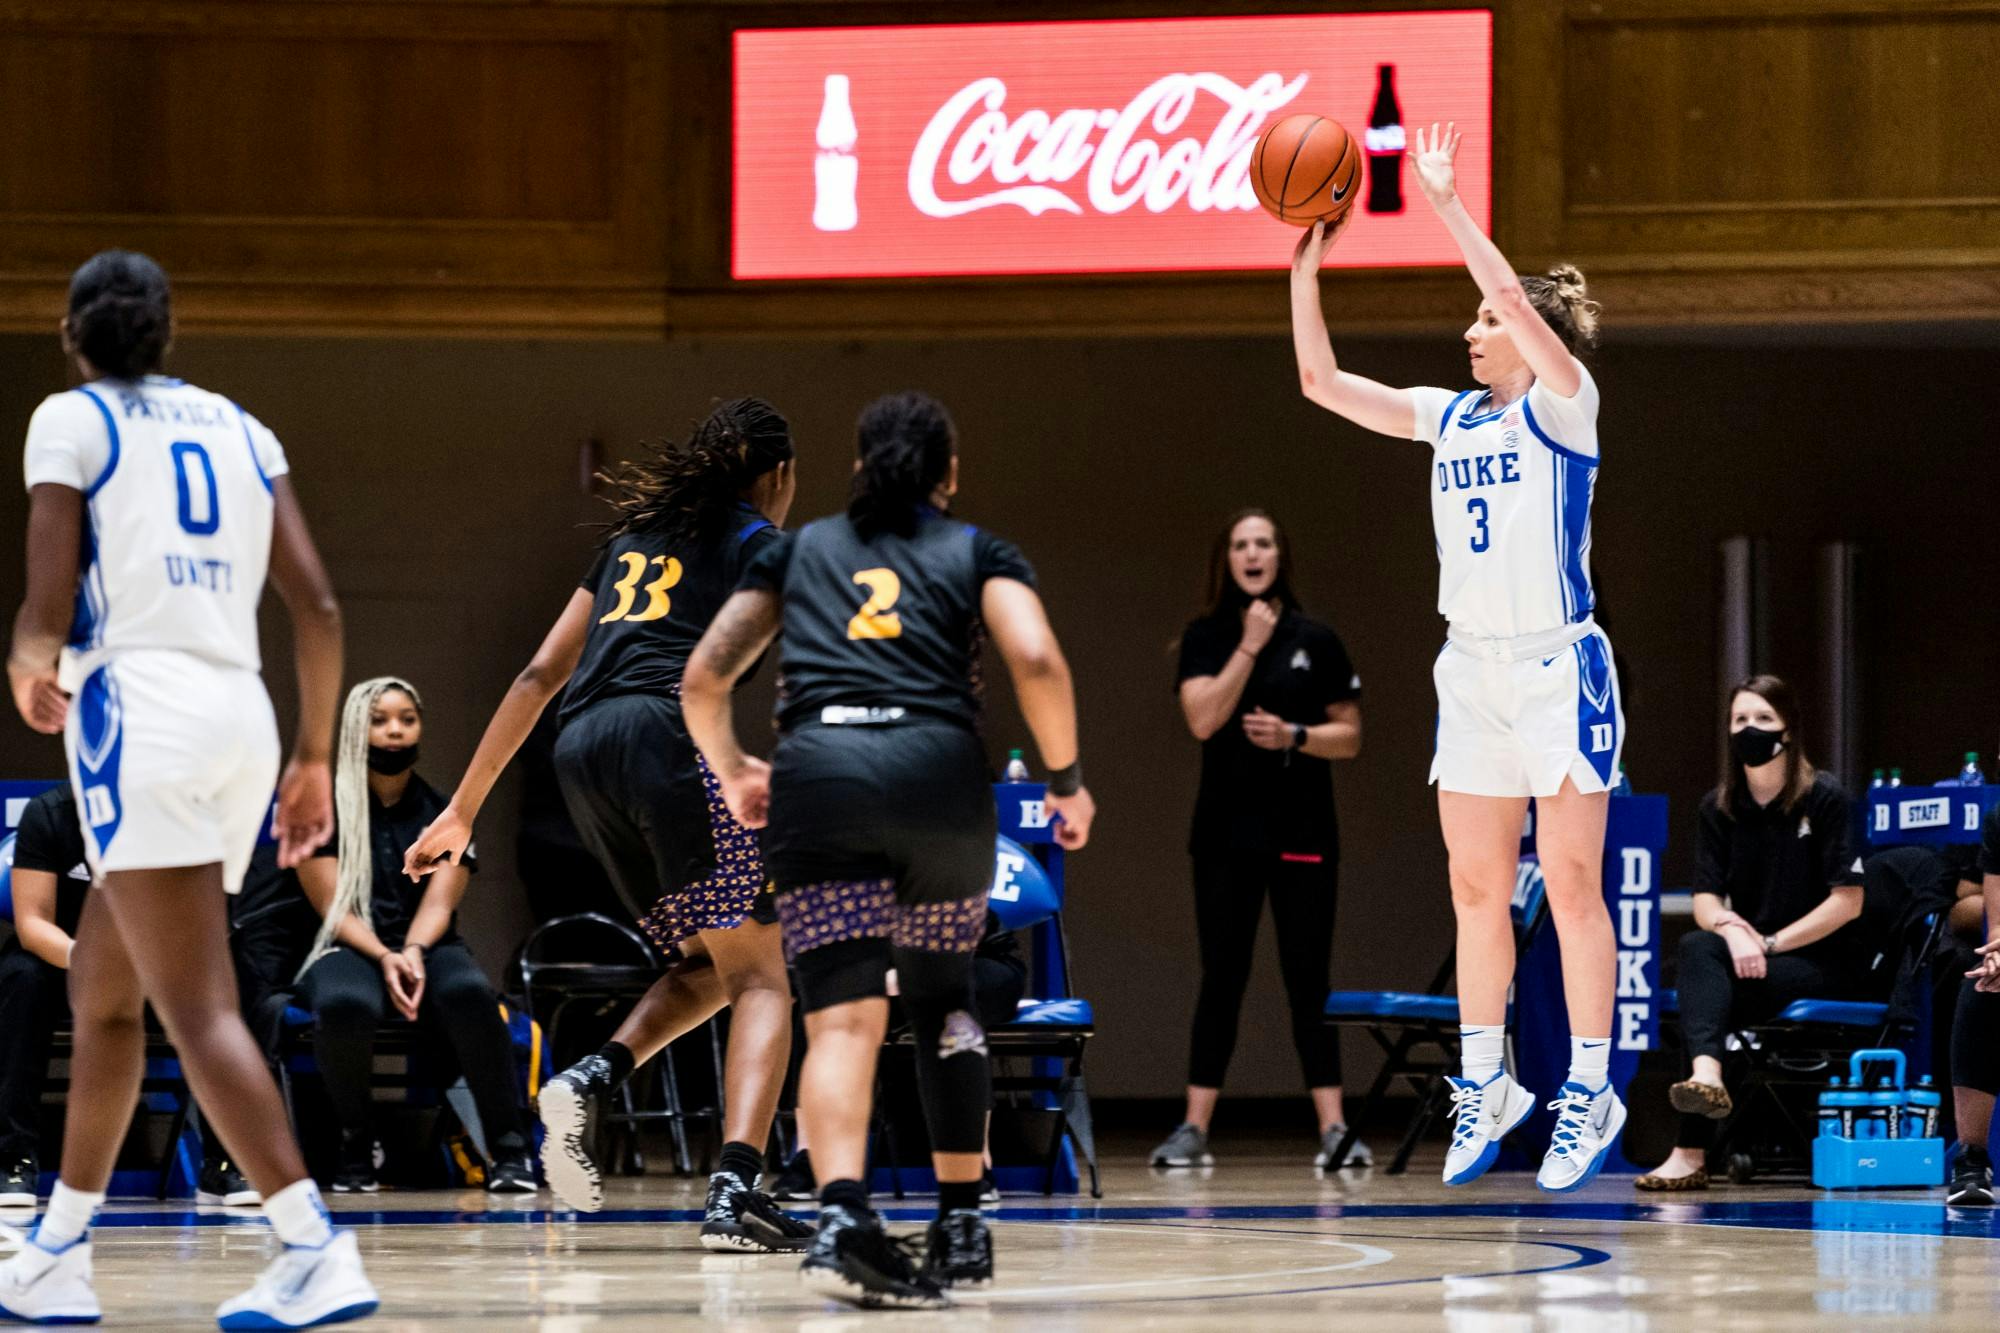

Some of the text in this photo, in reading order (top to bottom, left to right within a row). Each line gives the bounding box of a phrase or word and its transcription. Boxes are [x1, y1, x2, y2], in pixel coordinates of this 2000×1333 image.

[170, 441, 220, 535] 0
[1437, 452, 1521, 492] DUKE
[1466, 497, 1490, 554] 3
[599, 551, 684, 625] 33
[847, 567, 902, 641] 2
[1589, 723, 1613, 753] D
[1874, 804, 1890, 831] D
[1908, 803, 1940, 822] STAFF
[1963, 803, 1979, 830] D
[1617, 847, 1653, 1050] DUKE
